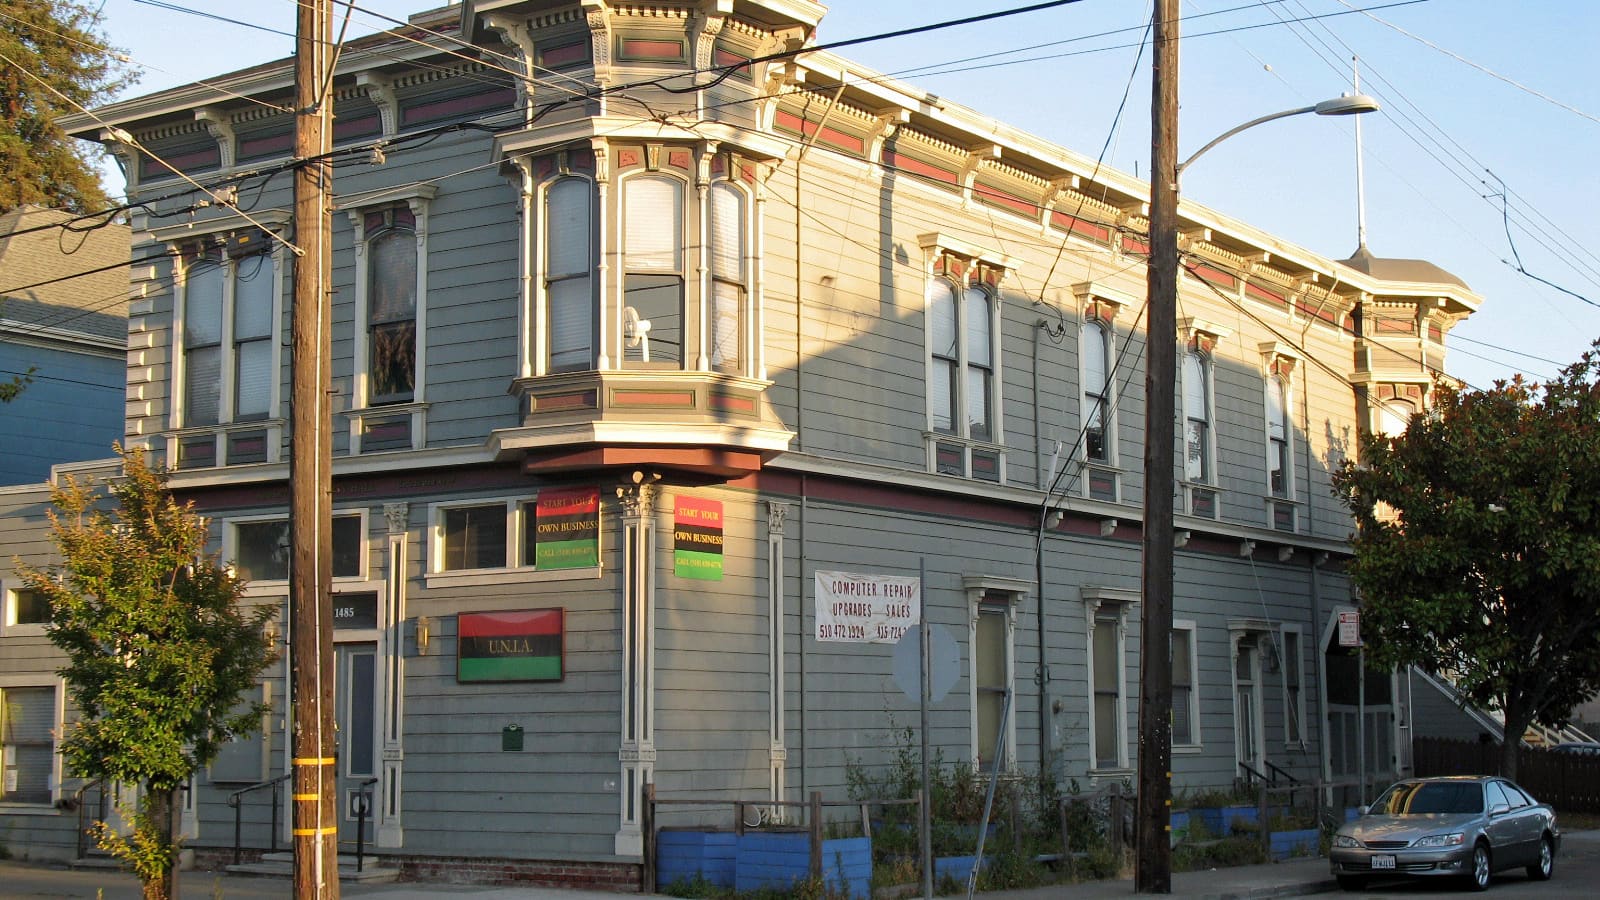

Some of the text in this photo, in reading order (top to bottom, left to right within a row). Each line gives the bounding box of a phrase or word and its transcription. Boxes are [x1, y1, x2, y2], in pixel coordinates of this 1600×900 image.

[543, 498, 566, 508] START
[679, 507, 719, 521] START YOUR
[538, 520, 599, 533] OWN BUSINESS
[675, 531, 723, 545] OWN BUSINESS
[832, 581, 912, 599] COMPUTER REPAIR
[335, 607, 354, 618] 1485
[833, 603, 911, 618] UPGRADES SALES
[834, 624, 846, 639] 472
[877, 625, 888, 639] 415
